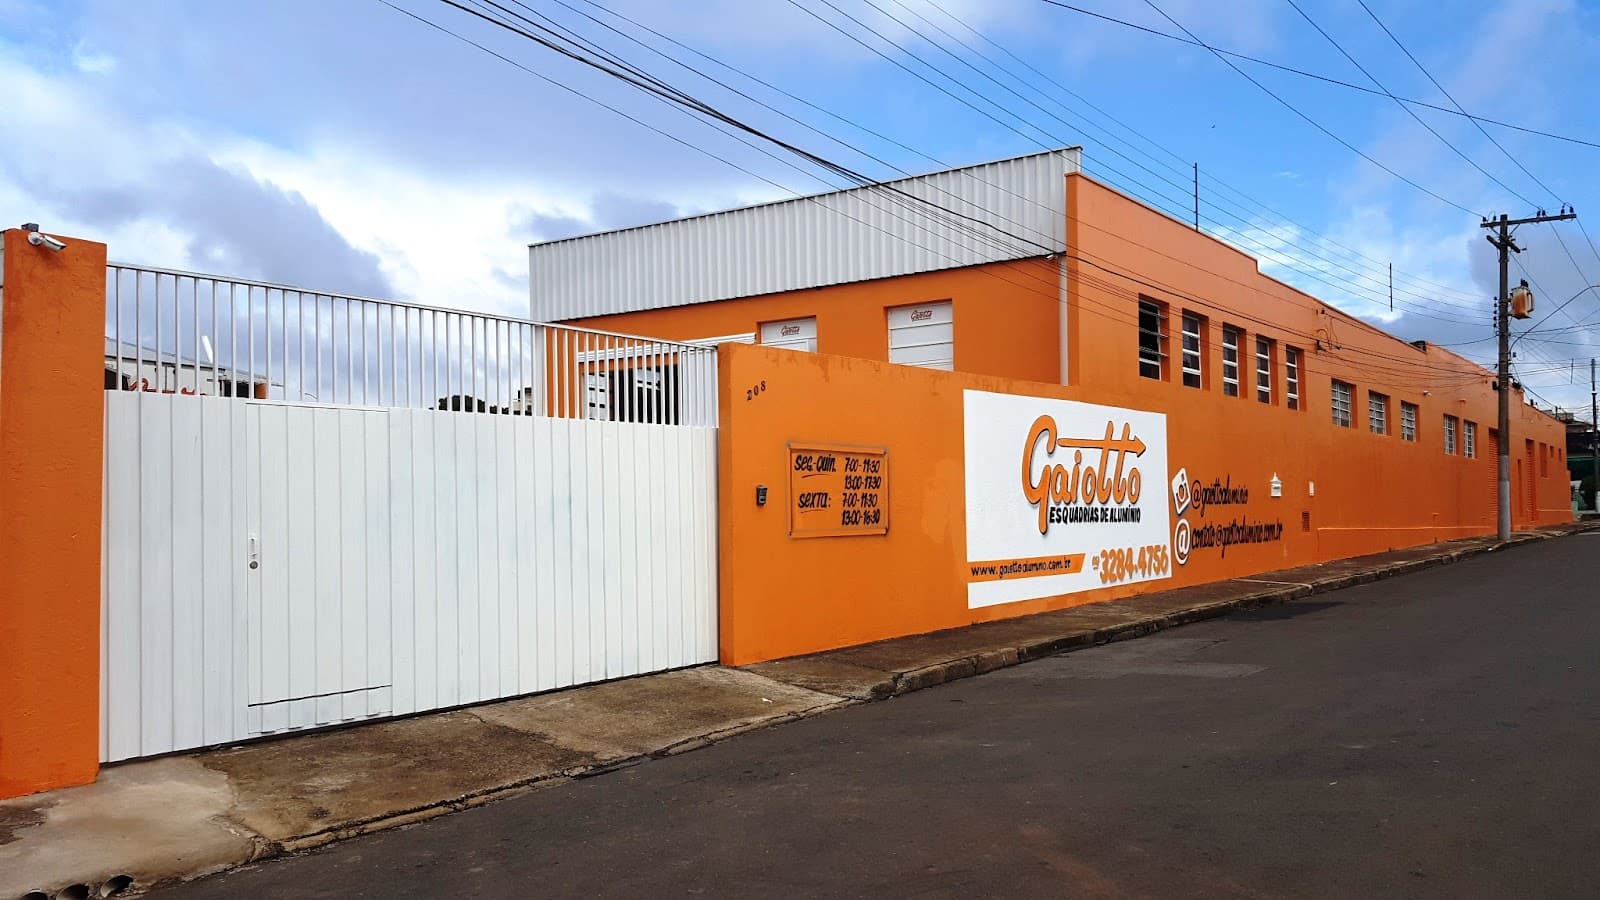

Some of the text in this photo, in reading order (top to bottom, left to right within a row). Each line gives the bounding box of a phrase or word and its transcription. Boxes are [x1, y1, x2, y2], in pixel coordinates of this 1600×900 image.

[746, 380, 766, 401] 208
[1022, 414, 1144, 535] Gaiotto
[1049, 506, 1099, 524] ESQUADRIAS
[1100, 507, 1109, 523] DE
